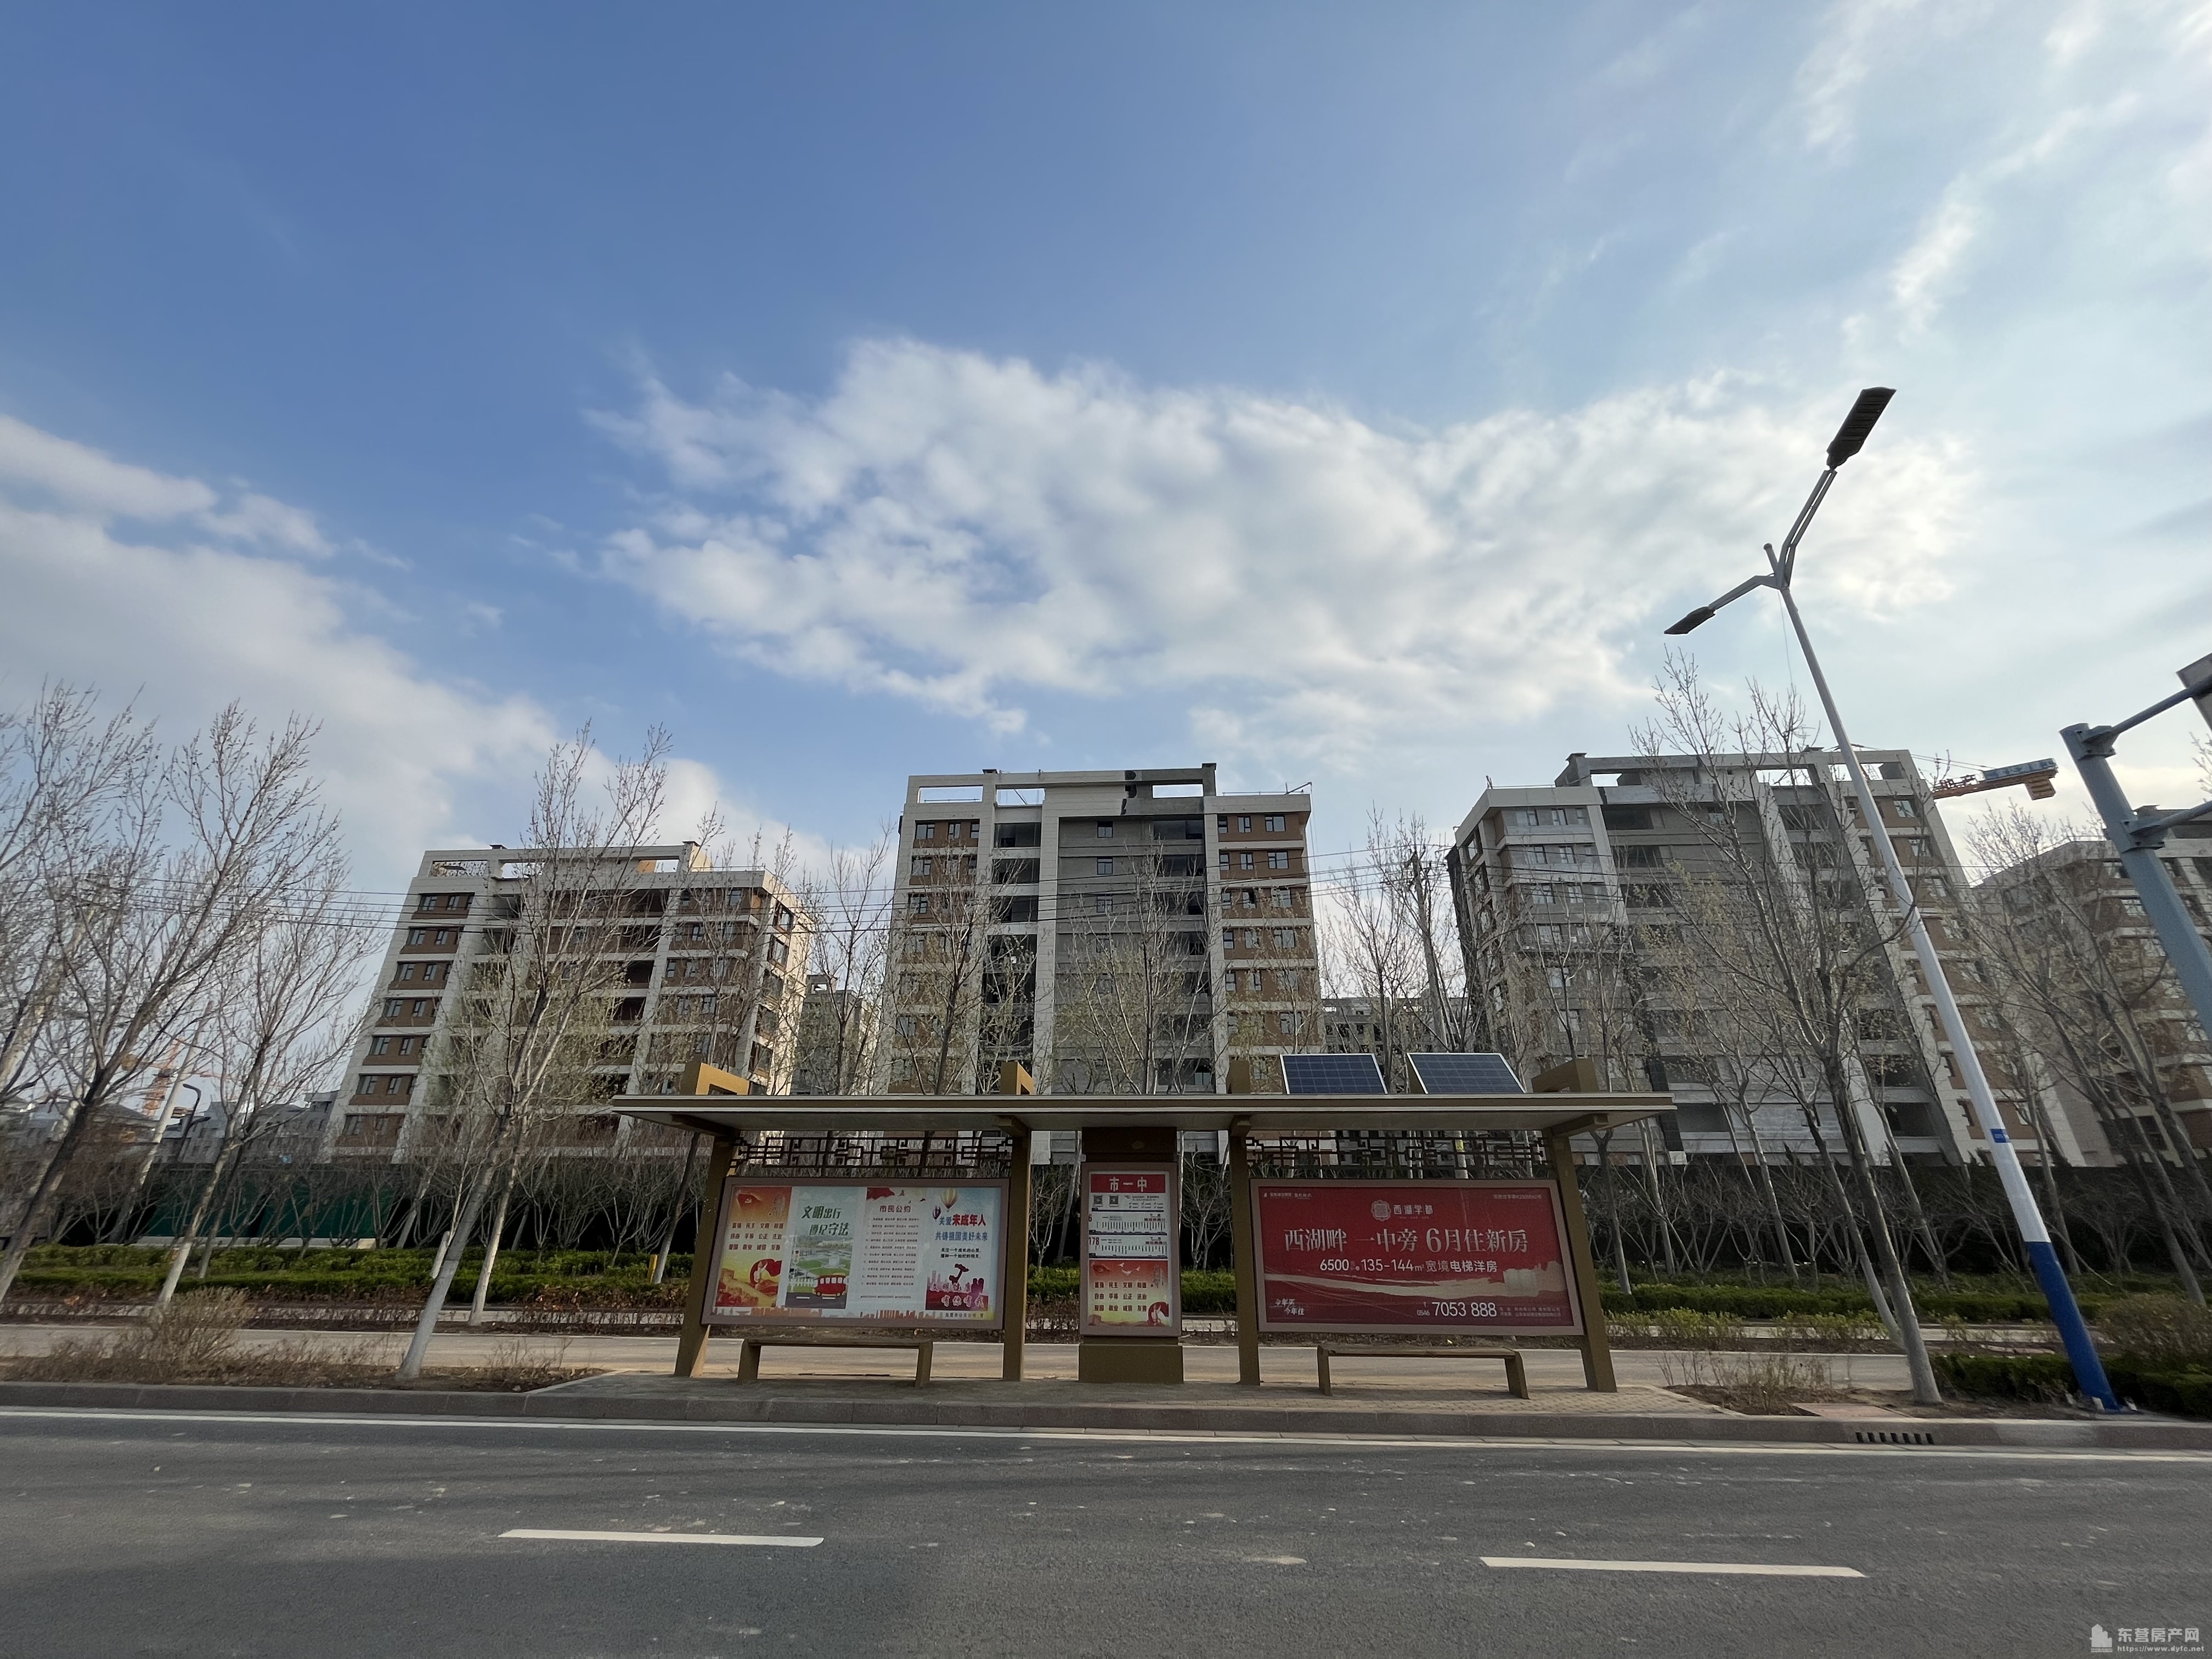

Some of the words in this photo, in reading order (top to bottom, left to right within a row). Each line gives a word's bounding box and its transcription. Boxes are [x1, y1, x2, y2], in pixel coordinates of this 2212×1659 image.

[1109, 1176, 1147, 1192] 市一中
[802, 1205, 842, 1219] 文明出行
[879, 1205, 911, 1213] 市民公约
[1393, 1204, 1434, 1215] 西湖学都
[939, 1214, 986, 1227] 关爱未成年人
[809, 1222, 850, 1236] 遵纪守法
[935, 1231, 988, 1242] 共铸祖国美好未来
[1088, 1237, 1099, 1245] 178
[1283, 1228, 1348, 1252] 西湖畔
[1355, 1228, 1419, 1252] 一中旁
[1426, 1227, 1528, 1254] 6月住新房
[1319, 1259, 1350, 1271] 6500
[941, 1295, 984, 1308] 有你有我
[1284, 1307, 1305, 1316] 今年住
[1431, 1302, 1467, 1317] 7053
[1470, 1302, 1497, 1317] 888
